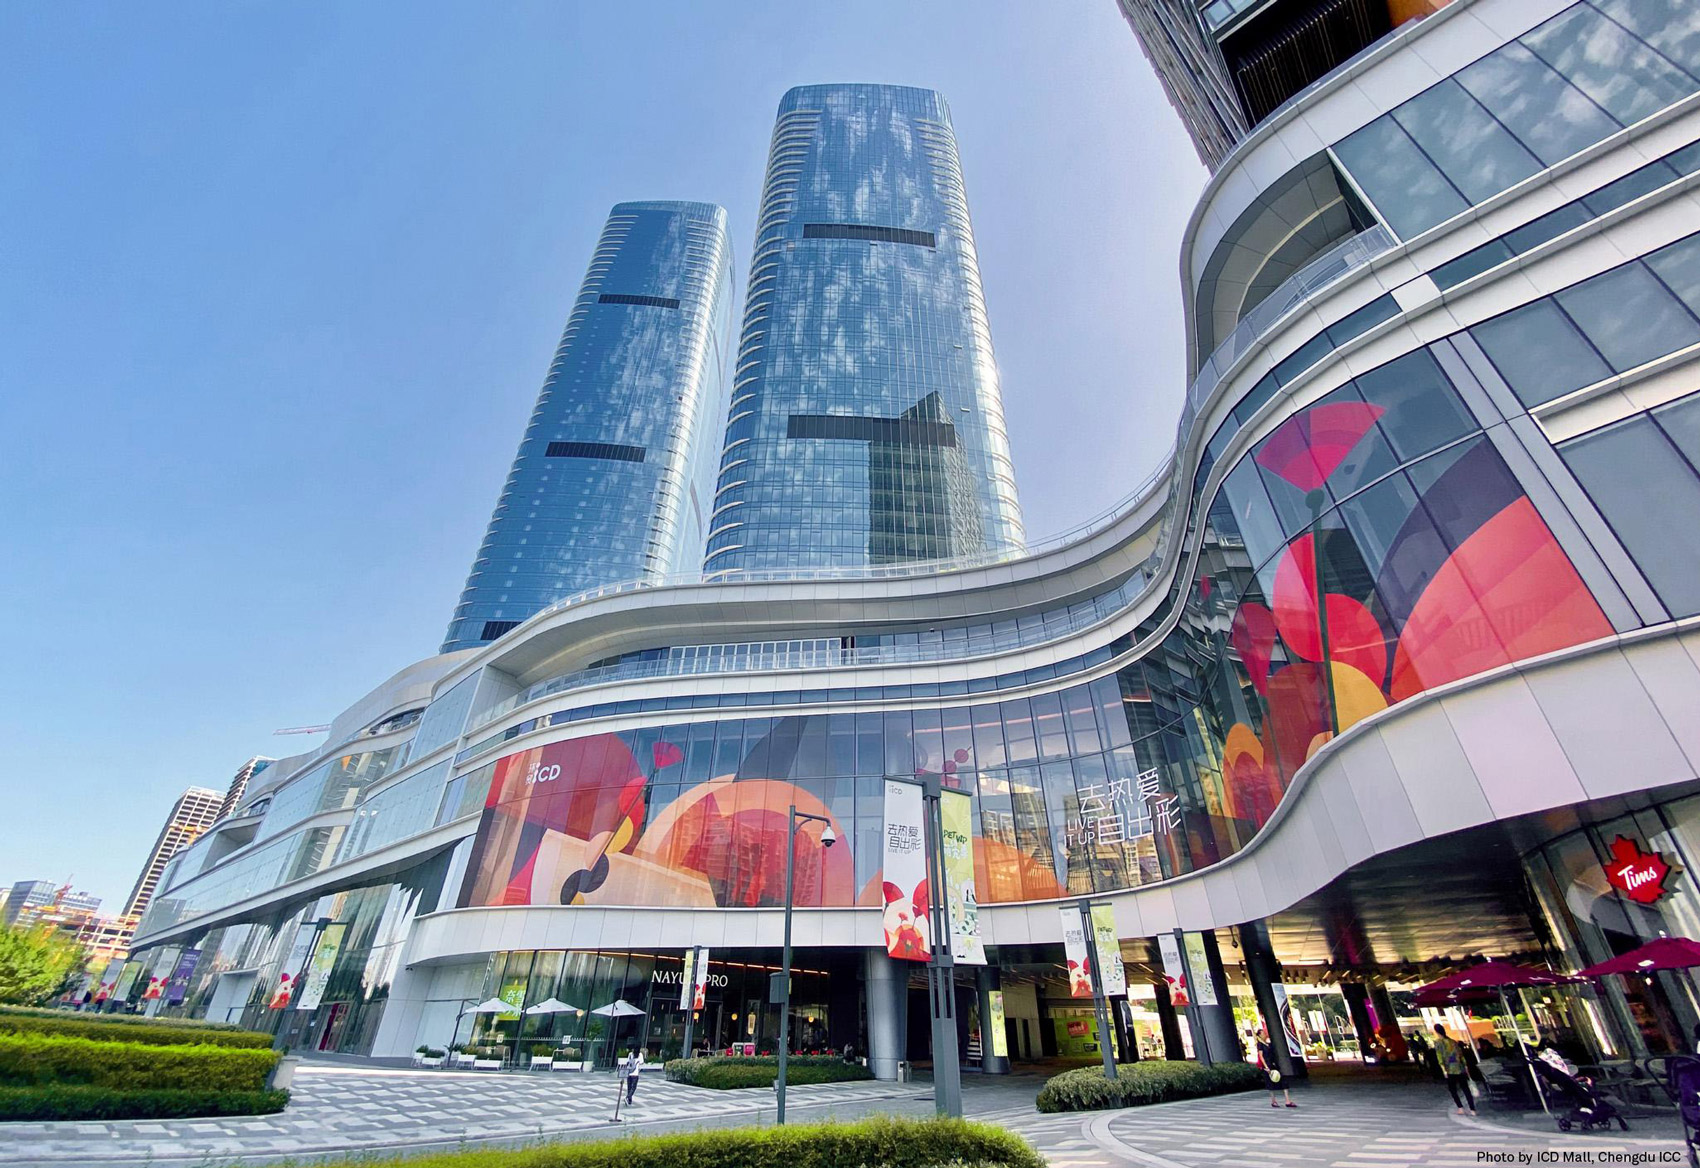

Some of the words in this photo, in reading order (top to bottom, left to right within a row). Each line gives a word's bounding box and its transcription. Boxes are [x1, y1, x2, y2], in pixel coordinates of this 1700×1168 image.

[1077, 767, 1160, 814] 去热爱
[888, 823, 918, 838] 去热爱
[1067, 815, 1097, 831] LIVE
[1098, 795, 1181, 845] 自出彩
[1064, 834, 1075, 847] IT
[1077, 831, 1095, 845] UP
[1617, 864, 1657, 890] Tims
